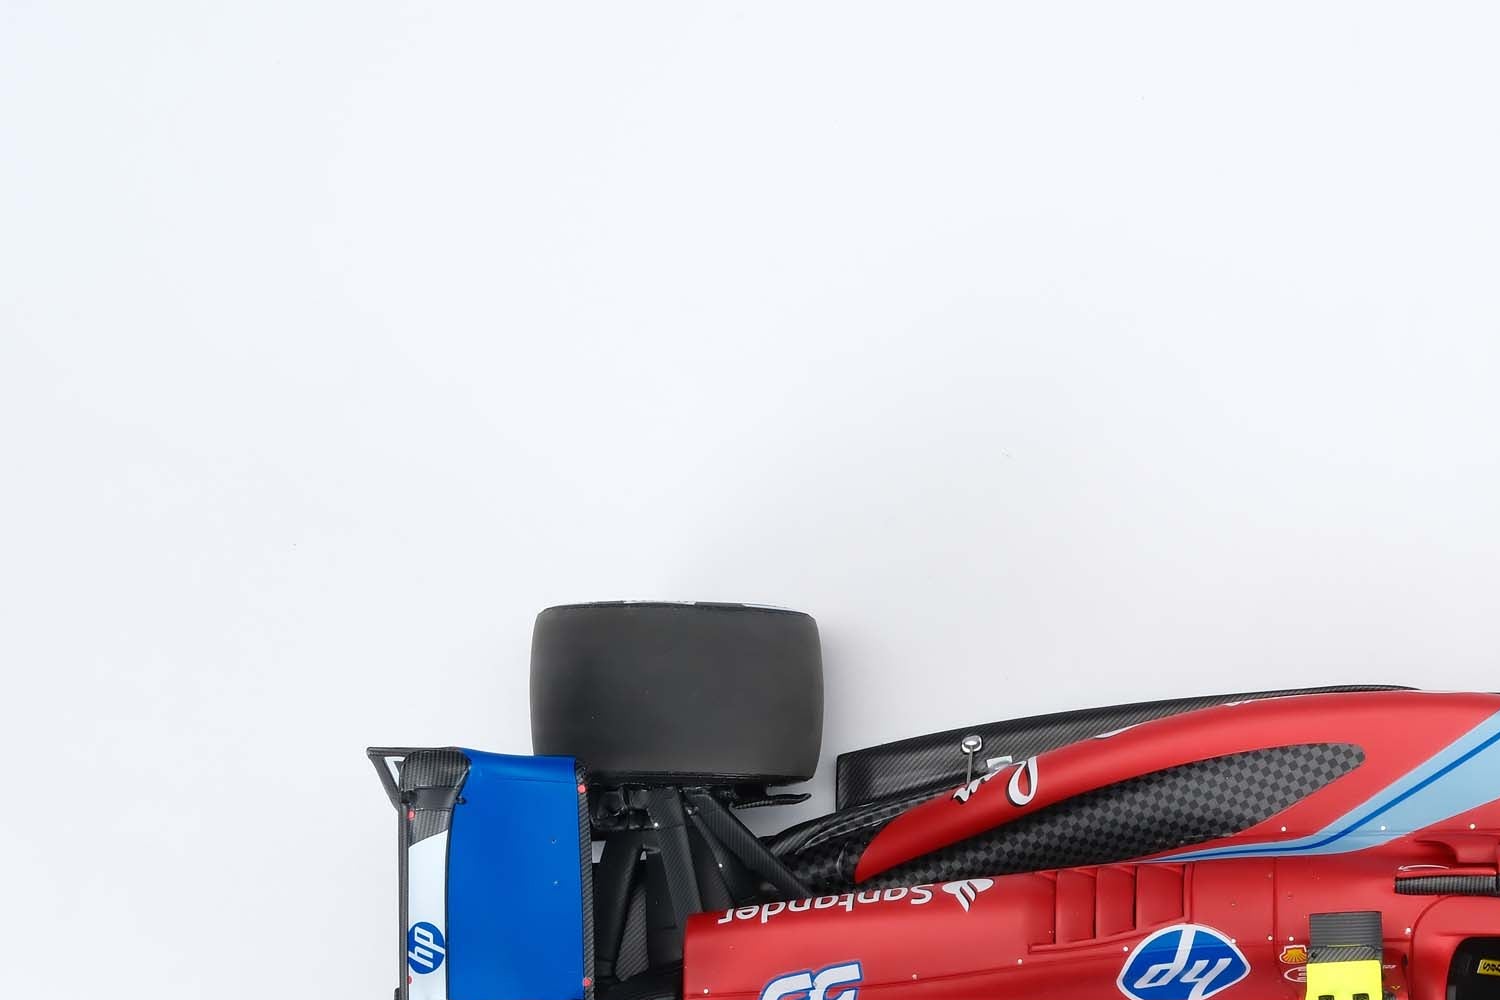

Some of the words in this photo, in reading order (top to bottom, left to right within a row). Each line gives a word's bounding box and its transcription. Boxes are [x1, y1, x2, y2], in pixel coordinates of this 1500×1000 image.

[717, 883, 935, 924] Santander
[407, 926, 447, 969] hp
[1133, 929, 1233, 1000] hp
